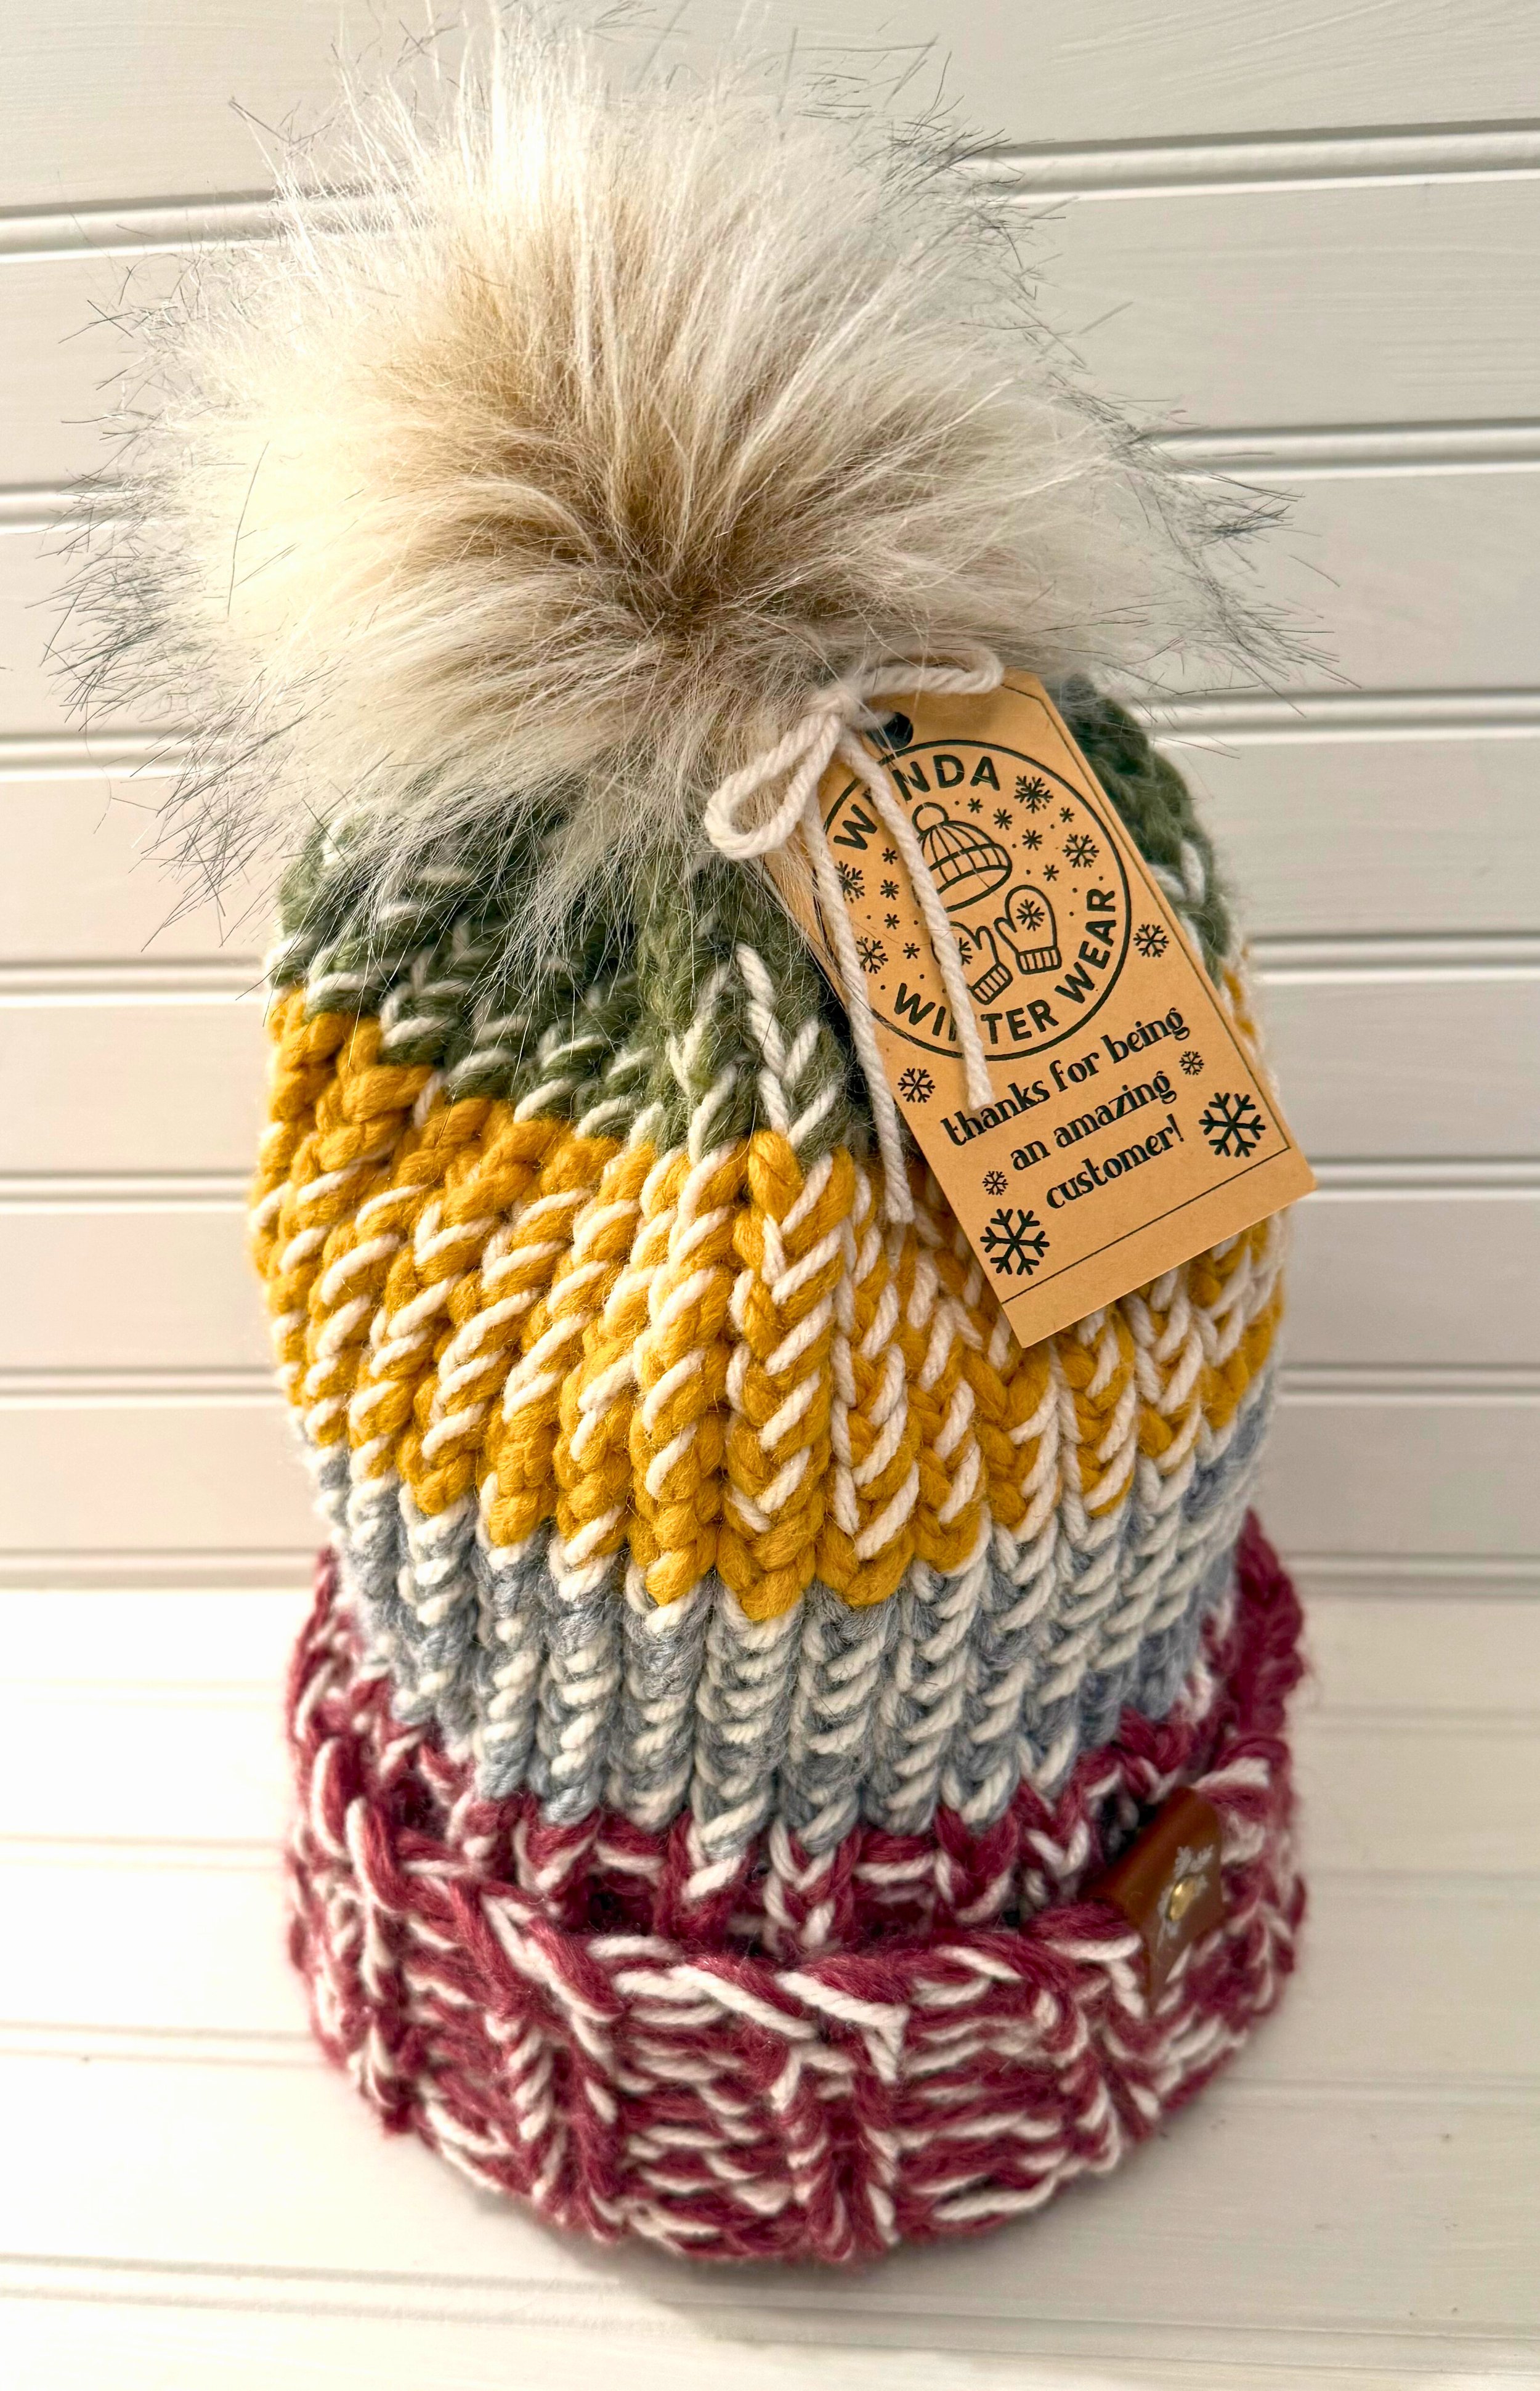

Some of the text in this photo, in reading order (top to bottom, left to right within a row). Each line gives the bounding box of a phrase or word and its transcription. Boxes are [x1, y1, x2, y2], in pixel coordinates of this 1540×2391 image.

[833, 755, 1000, 850] WNDA
[1055, 888, 1116, 1004] WEAR
[941, 1007, 1190, 1146] thanks for being
[1010, 1071, 1177, 1170] an amazing
[1046, 1114, 1184, 1209] customer!
